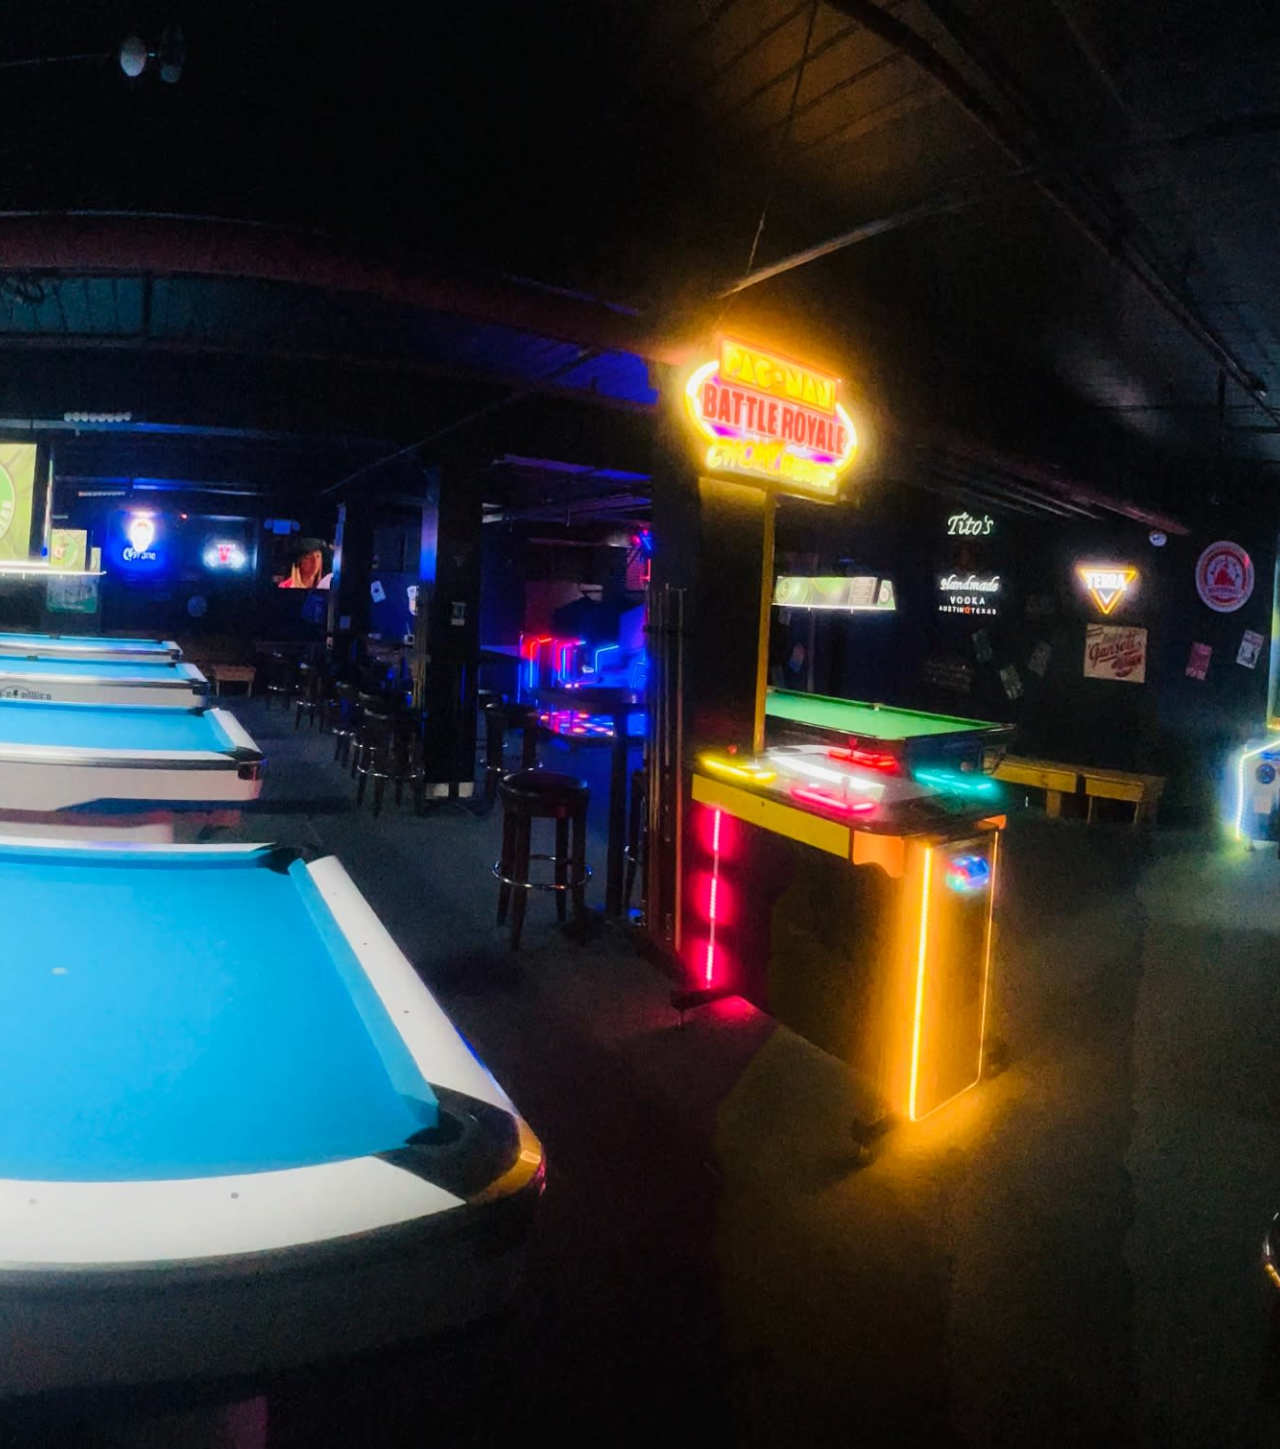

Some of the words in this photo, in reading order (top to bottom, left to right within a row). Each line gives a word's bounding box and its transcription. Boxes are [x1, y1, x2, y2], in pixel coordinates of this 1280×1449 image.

[704, 383, 777, 434] BATTLE
[781, 408, 846, 456] ROYALE
[946, 511, 995, 535] Tito's
[939, 573, 1000, 593] Handmade
[949, 595, 986, 606] VODKA
